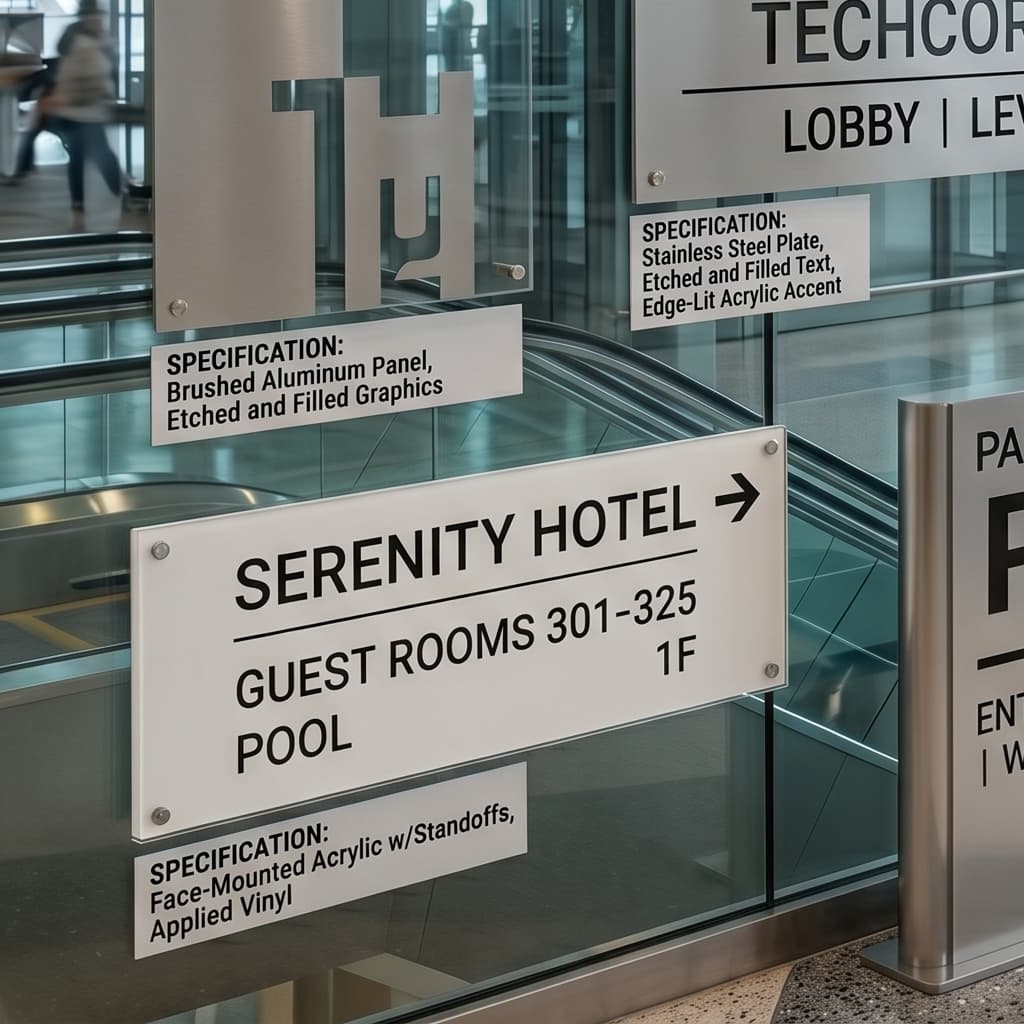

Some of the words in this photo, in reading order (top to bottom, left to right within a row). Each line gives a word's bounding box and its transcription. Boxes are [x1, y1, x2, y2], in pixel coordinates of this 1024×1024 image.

[785, 101, 919, 152] LOBBY
[643, 211, 785, 242] SPECIFICATION:
[643, 243, 722, 267] Stainless
[729, 235, 770, 257] Steel
[777, 232, 823, 252] Plate,
[643, 266, 702, 292] Etched
[709, 262, 739, 284] and
[746, 257, 790, 280] Filled
[796, 254, 834, 274] Text,
[644, 291, 715, 319] Edge-Lit
[720, 284, 778, 309] Acrylic
[784, 277, 841, 300] Accent
[167, 335, 342, 375] SPECIFICATION:
[168, 371, 254, 402] Brushed
[262, 364, 365, 391] Aluminum
[373, 350, 432, 376] Panel,
[168, 400, 240, 430] Etched
[248, 394, 285, 419] and
[294, 386, 348, 413] Filled
[356, 377, 442, 406] Graphics
[236, 514, 515, 610] SERENITY
[534, 485, 696, 556] HOTEL
[237, 645, 375, 708] GUEST
[391, 614, 534, 678] ROOMS
[547, 580, 696, 643] 301-325
[657, 635, 696, 675] 1F
[238, 715, 352, 774] POOL
[150, 823, 328, 885] SPECIFICATION:
[151, 853, 304, 914] Face-Mounted
[312, 838, 382, 872] Acrylic
[389, 804, 514, 851] w/Standoffs,
[150, 899, 232, 943] Applied
[240, 884, 291, 916] Vinyl
